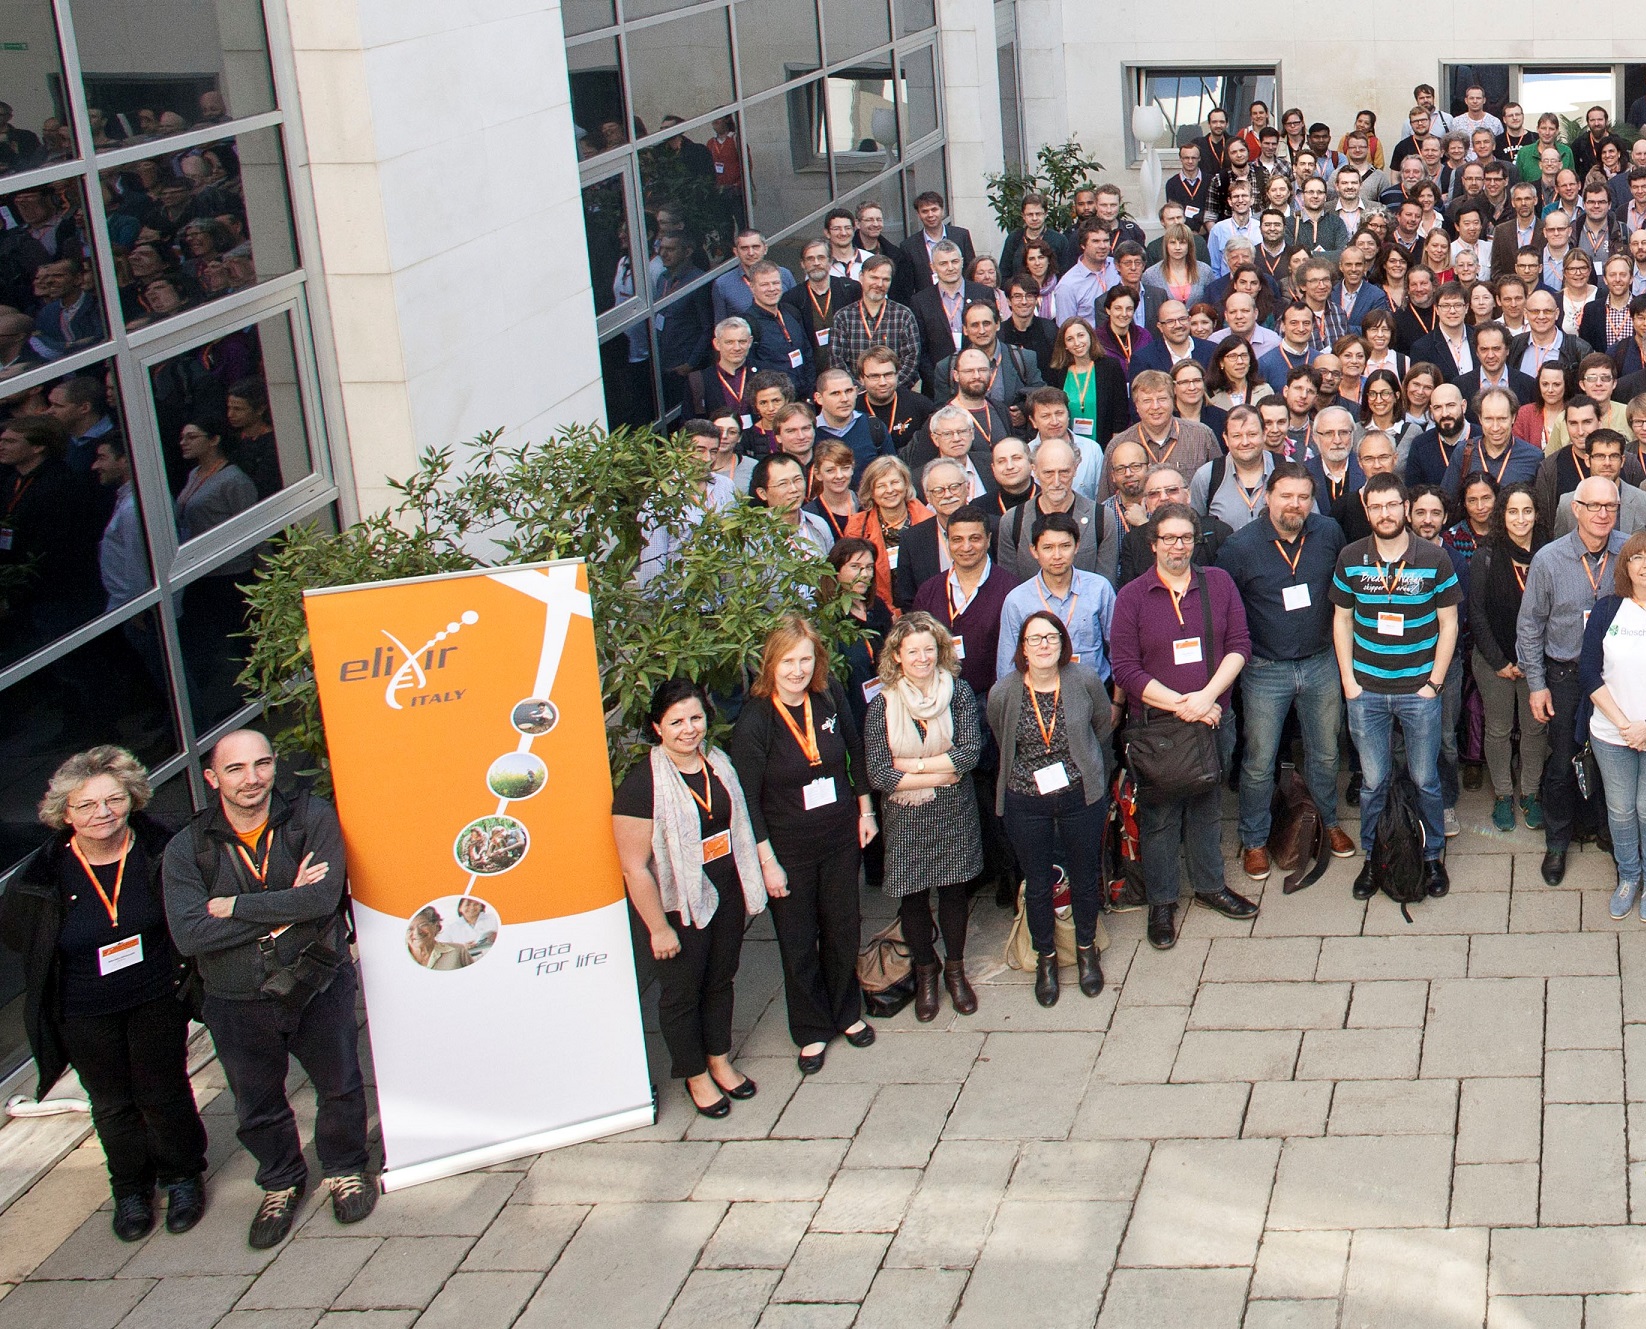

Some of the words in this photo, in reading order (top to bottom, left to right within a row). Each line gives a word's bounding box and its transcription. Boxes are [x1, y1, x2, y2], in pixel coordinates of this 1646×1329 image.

[339, 629, 458, 709] elixir
[411, 689, 467, 707] ITALY
[518, 943, 571, 963] Data
[536, 961, 569, 976] for
[576, 952, 607, 968] life
